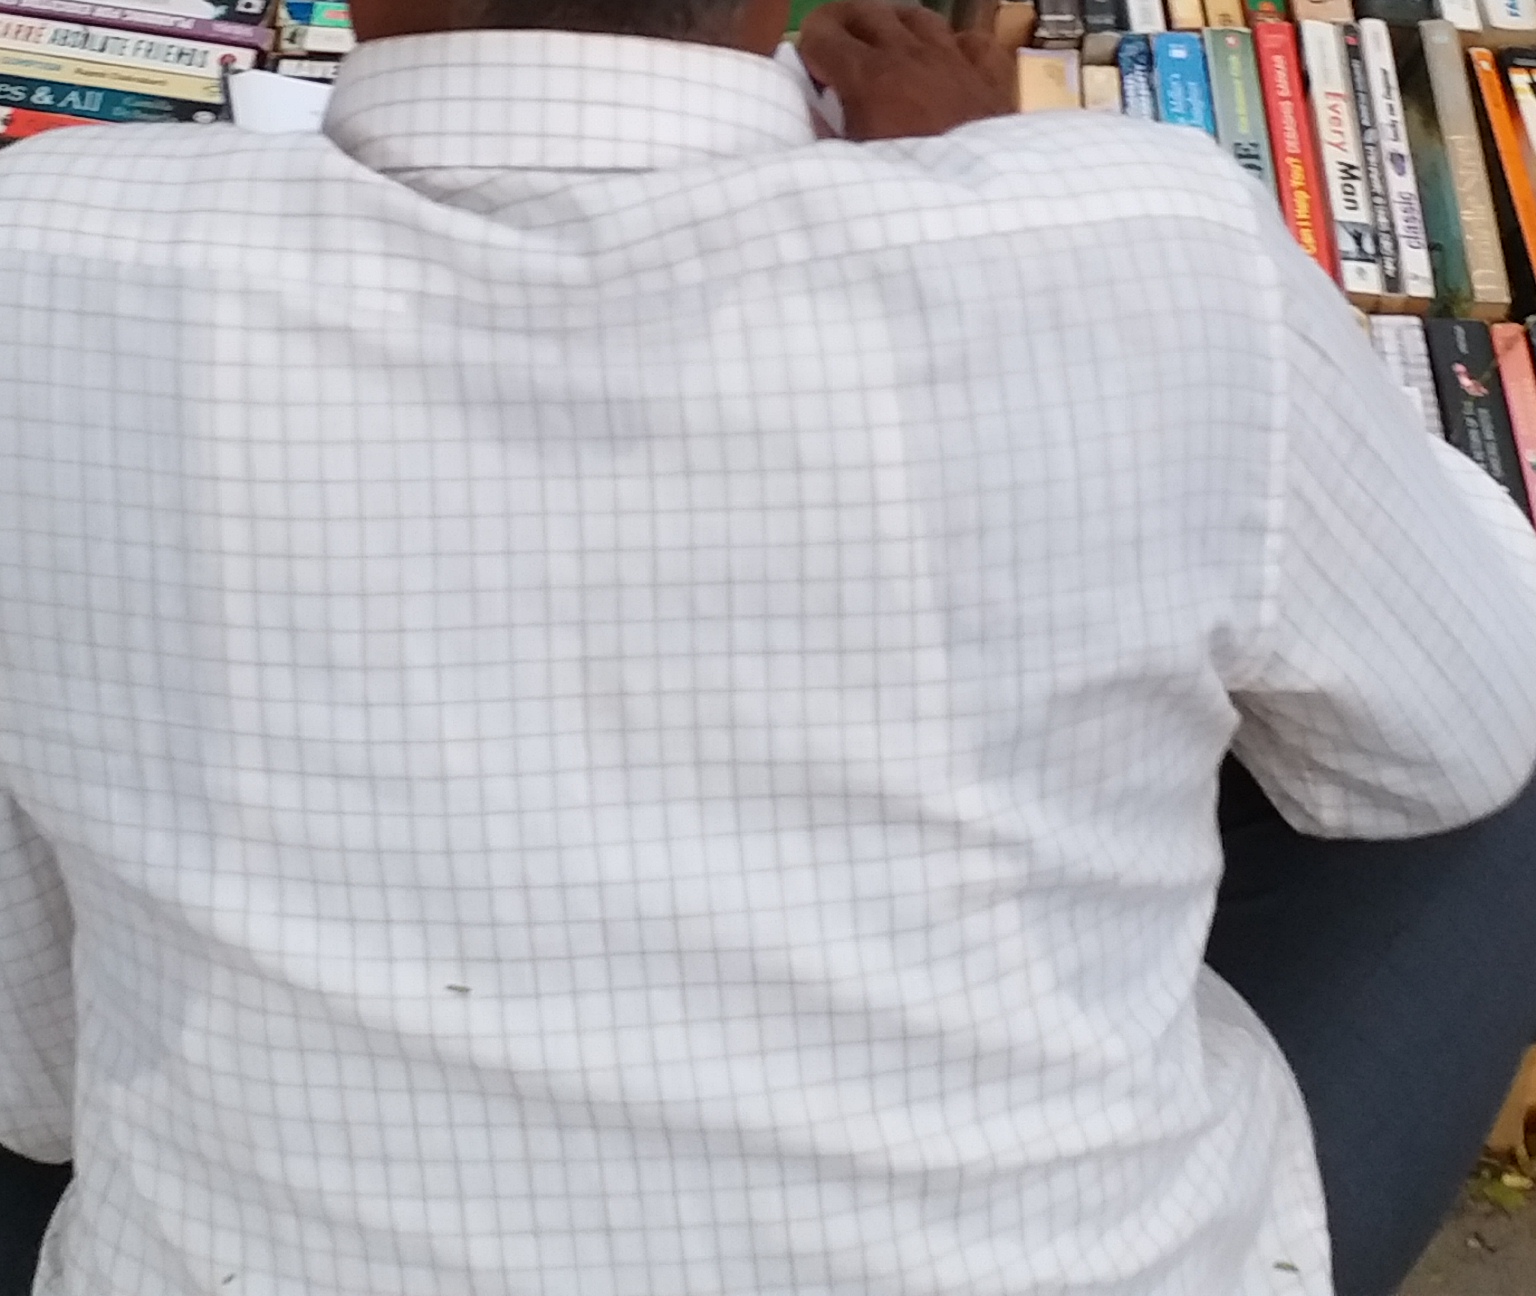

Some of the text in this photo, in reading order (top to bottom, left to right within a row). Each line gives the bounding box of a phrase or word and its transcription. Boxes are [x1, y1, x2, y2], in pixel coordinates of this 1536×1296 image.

[31, 83, 56, 107] &
[65, 85, 105, 114] All
[1321, 90, 1363, 213] Every Man
